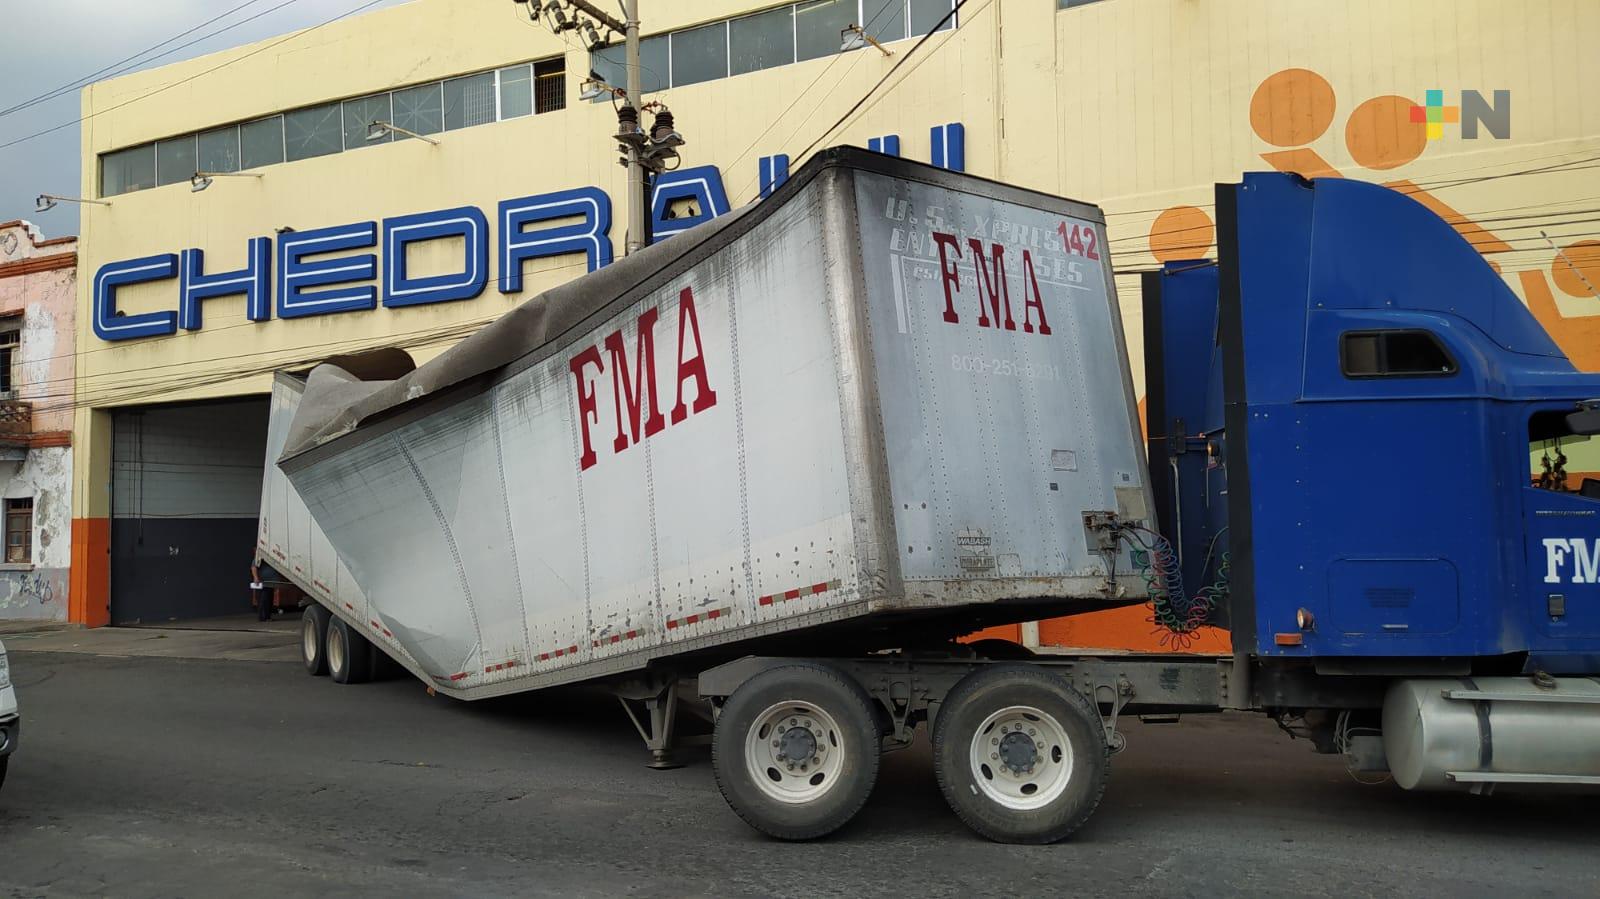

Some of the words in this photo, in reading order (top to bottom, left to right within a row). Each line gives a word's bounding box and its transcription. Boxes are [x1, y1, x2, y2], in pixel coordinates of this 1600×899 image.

[93, 122, 966, 342] CHEDRA
[932, 231, 1052, 335] FMA
[1057, 221, 1099, 261] 142
[569, 286, 717, 472] FMA
